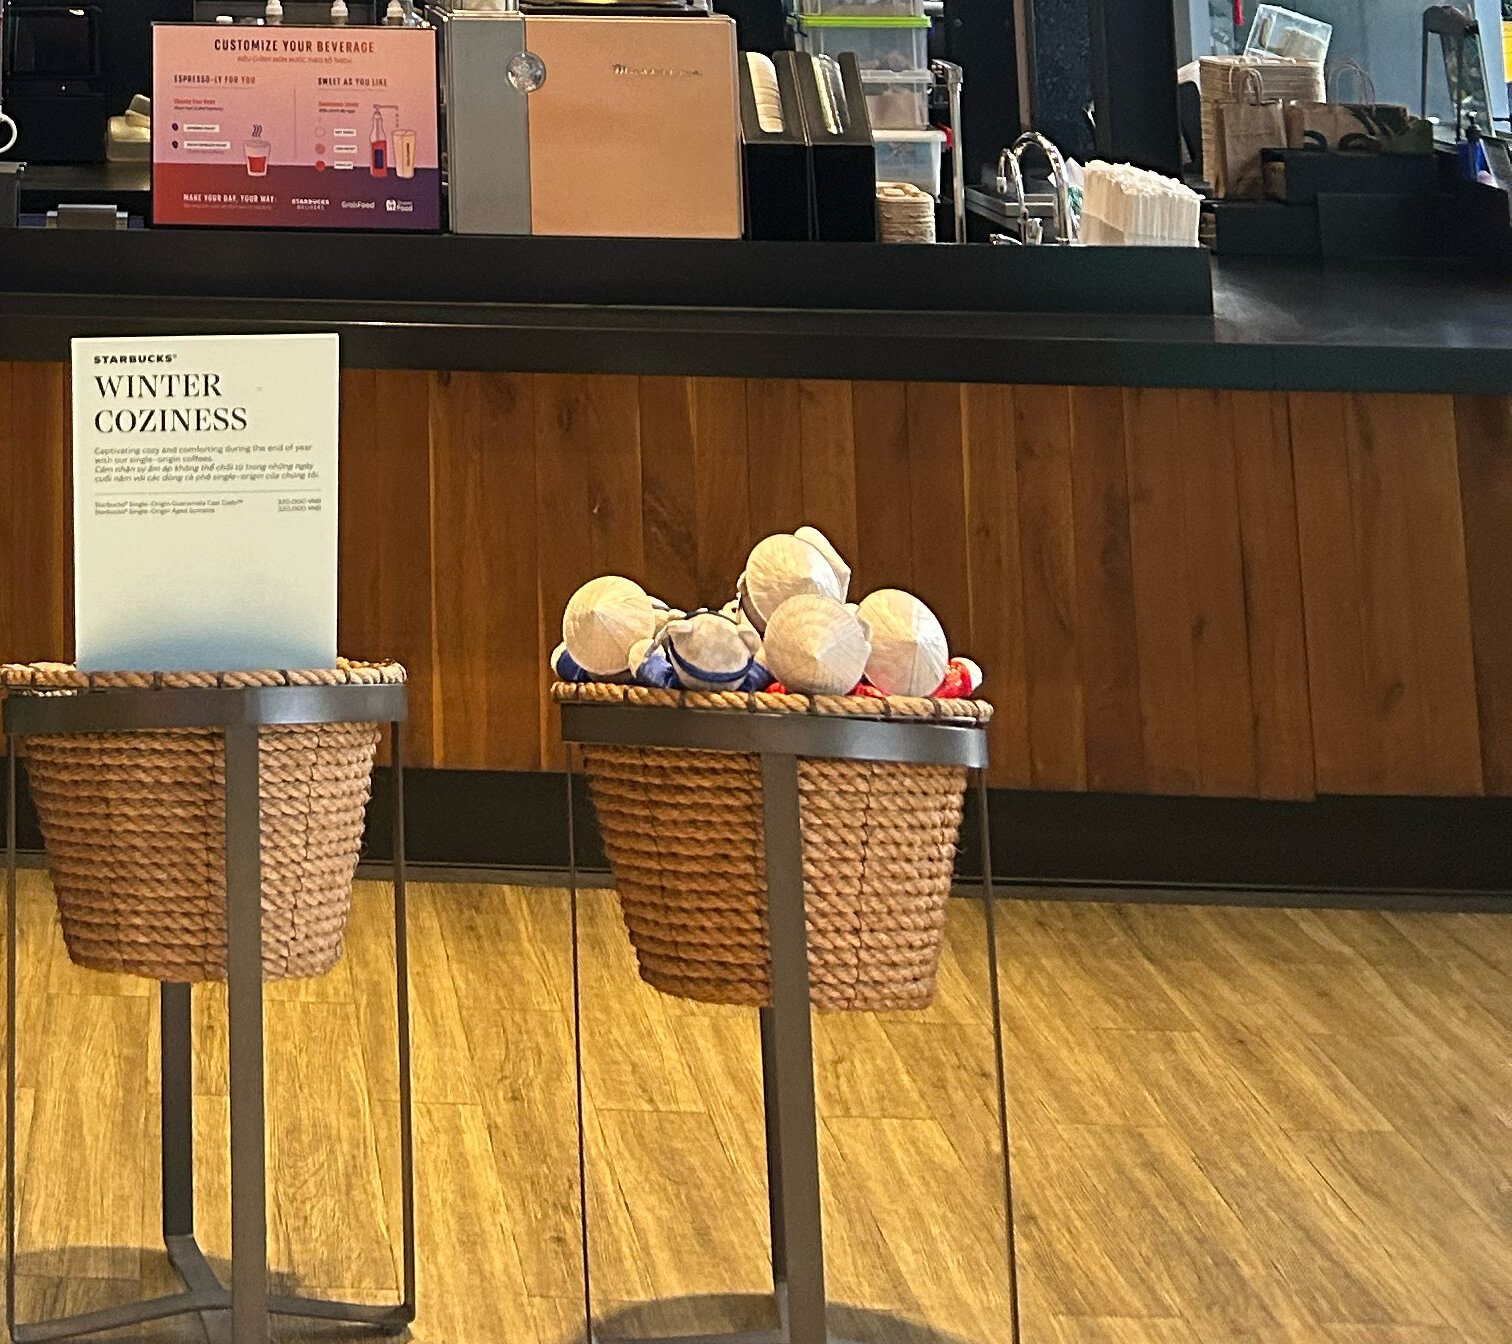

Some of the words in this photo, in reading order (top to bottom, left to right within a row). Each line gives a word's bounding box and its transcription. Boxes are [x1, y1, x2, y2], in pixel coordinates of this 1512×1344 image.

[214, 39, 278, 52] CUSTOMIZE
[282, 40, 312, 52] YOUR
[316, 41, 375, 54] BEVERAGE
[224, 75, 239, 84] FOR
[241, 76, 256, 85] YOU
[317, 76, 341, 86] SWEET
[342, 77, 354, 86] AS
[355, 77, 370, 87] YOU
[371, 78, 388, 87] LIKE
[94, 372, 222, 399] WINTER
[94, 406, 248, 434] COZINESS
[95, 446, 141, 455] Captivating
[142, 447, 160, 455] cozy
[162, 446, 178, 454] and
[178, 445, 224, 455] comforting
[225, 445, 251, 453] during
[252, 444, 266, 452] the
[267, 444, 284, 452] end
[284, 443, 294, 451] of
[295, 444, 313, 453] year
[95, 456, 112, 464] with
